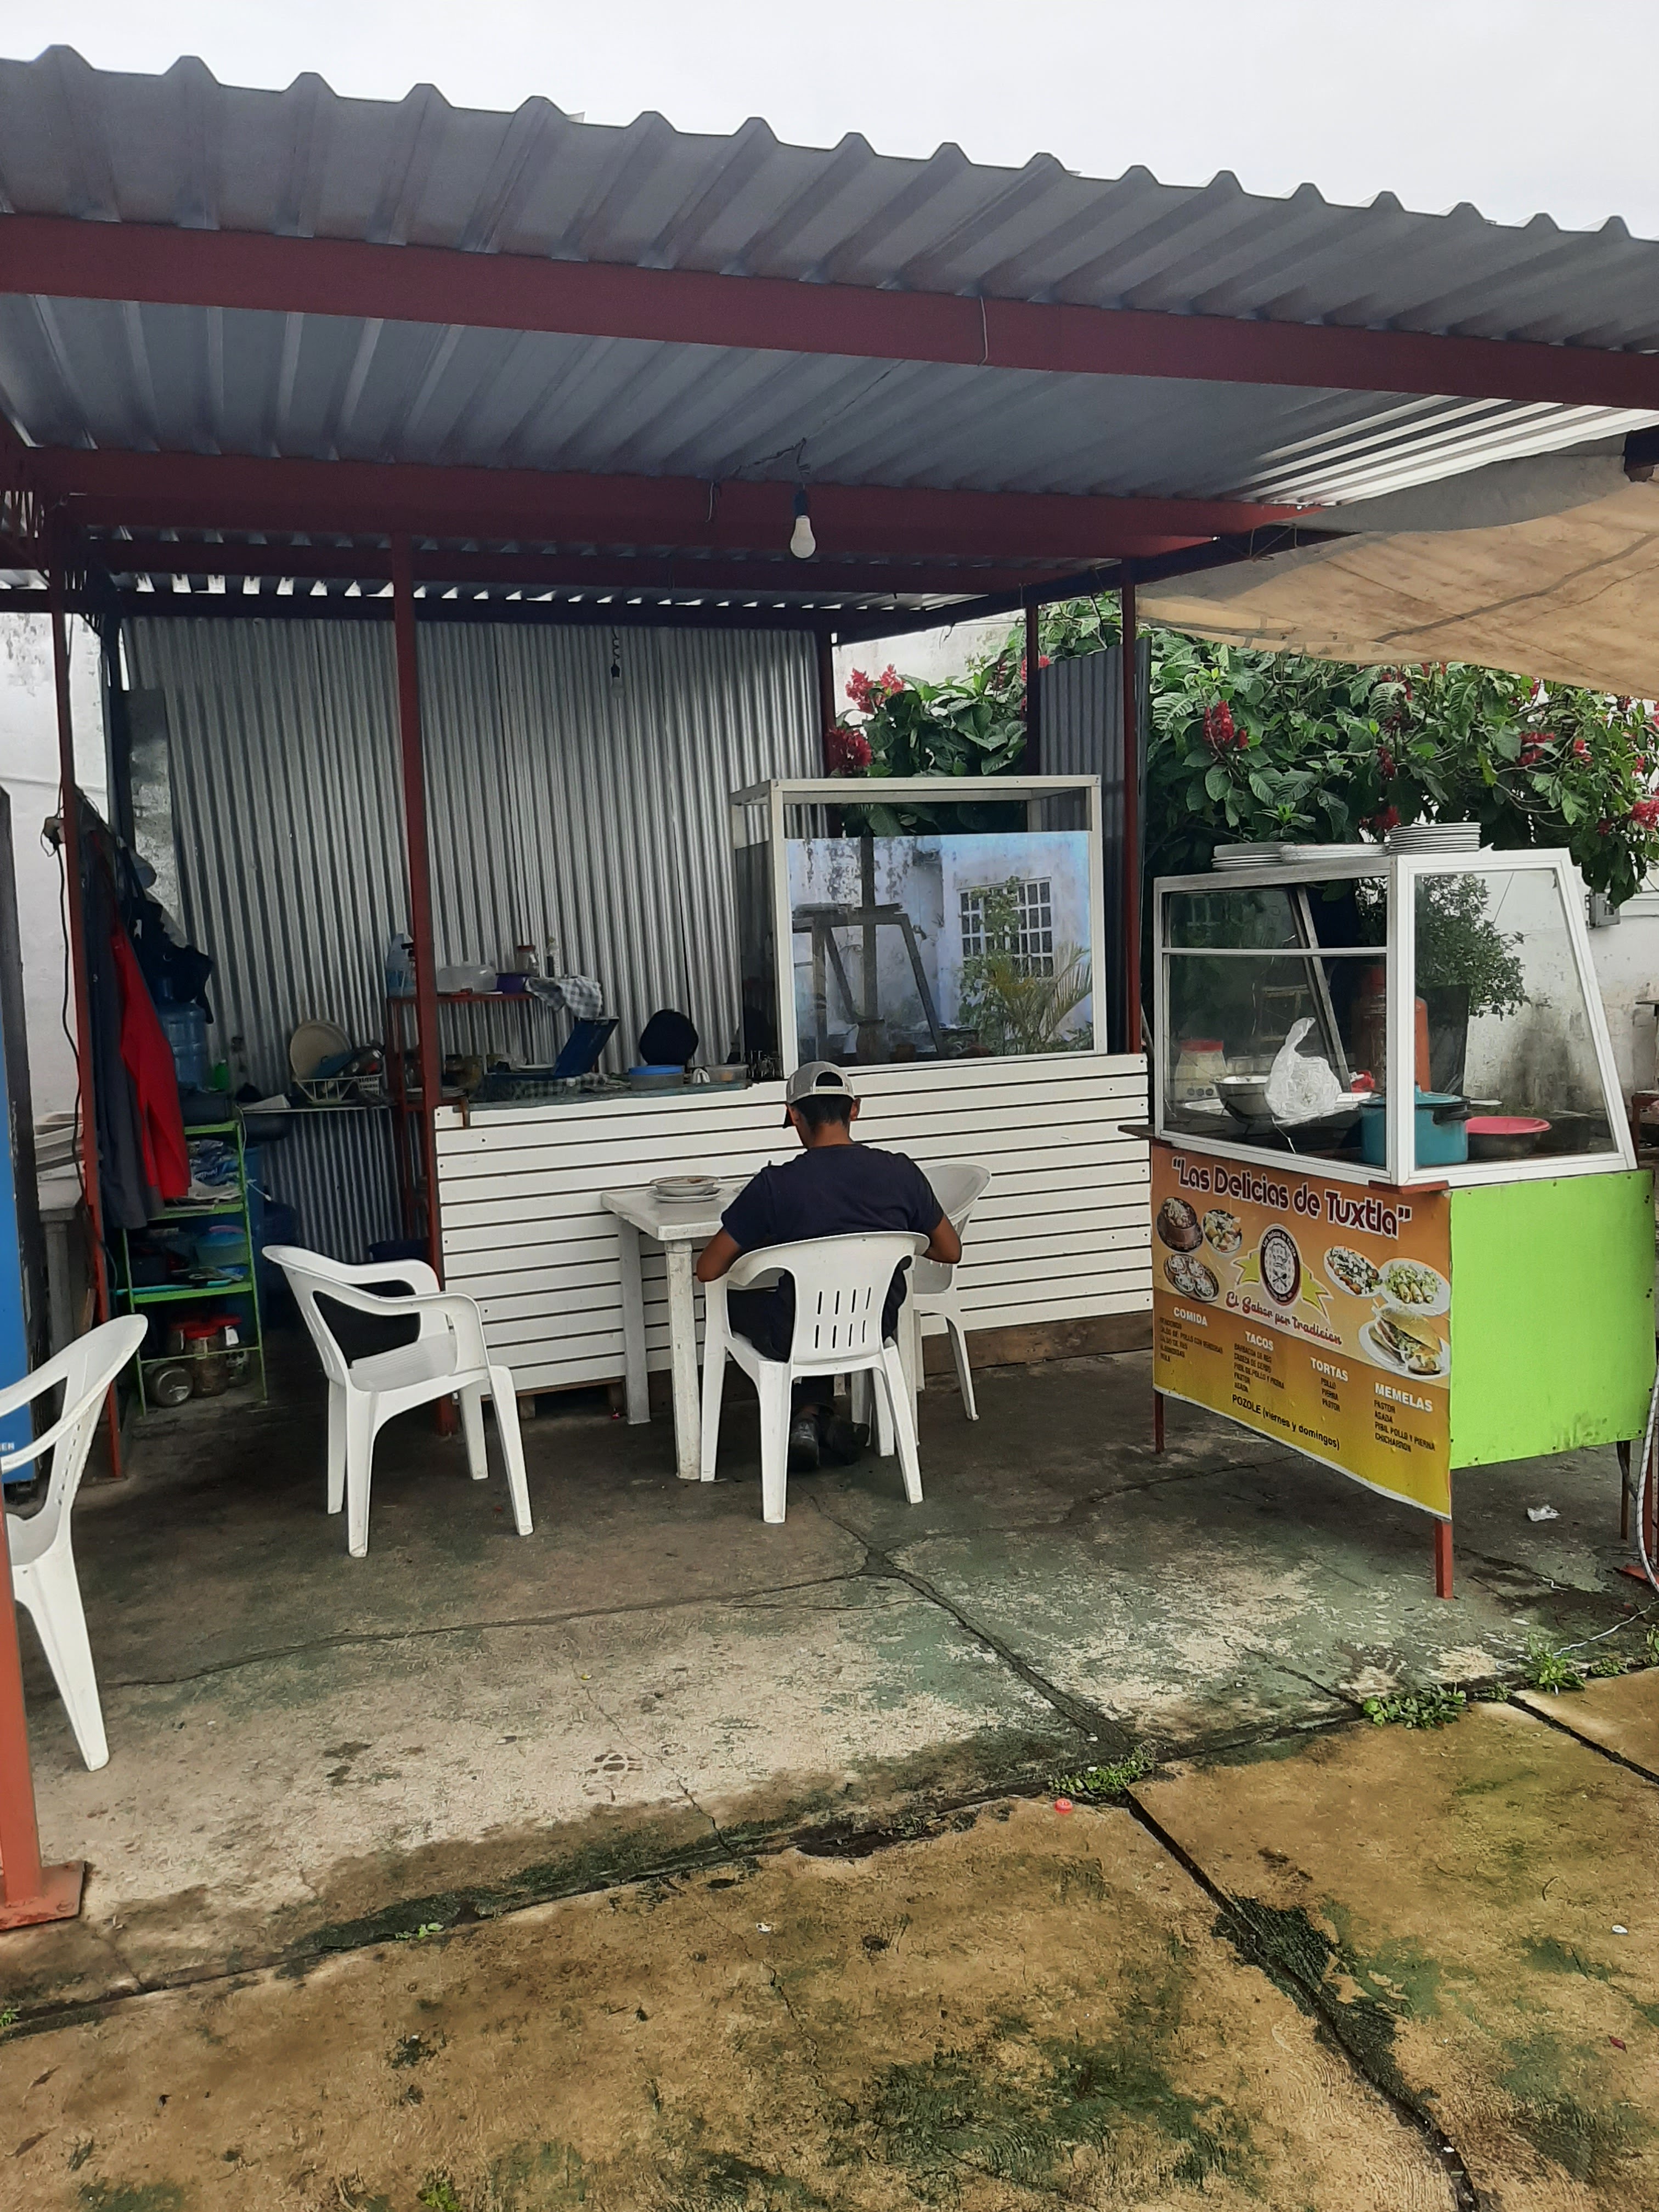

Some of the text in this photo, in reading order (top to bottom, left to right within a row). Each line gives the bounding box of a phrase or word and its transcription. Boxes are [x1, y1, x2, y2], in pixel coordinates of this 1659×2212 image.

[1213, 1164, 1289, 1211] Delicias
[1293, 1181, 1321, 1219] de
[1173, 1307, 1208, 1327] COMIDA
[1226, 1291, 1239, 1308] El
[1242, 1296, 1273, 1317] Sabor
[1275, 1312, 1291, 1325] por
[1245, 1330, 1273, 1351] TACOS
[1310, 1357, 1348, 1382] TORTAS
[1374, 1400, 1396, 1414] PASTOR
[1375, 1382, 1434, 1412] MEMELAS
[1232, 1394, 1340, 1451] POZOLE (viernes y domingos)
[1374, 1410, 1393, 1423] ASADA
[1390, 1426, 1408, 1440] POLLO
[1414, 1436, 1435, 1451] PIERNA
